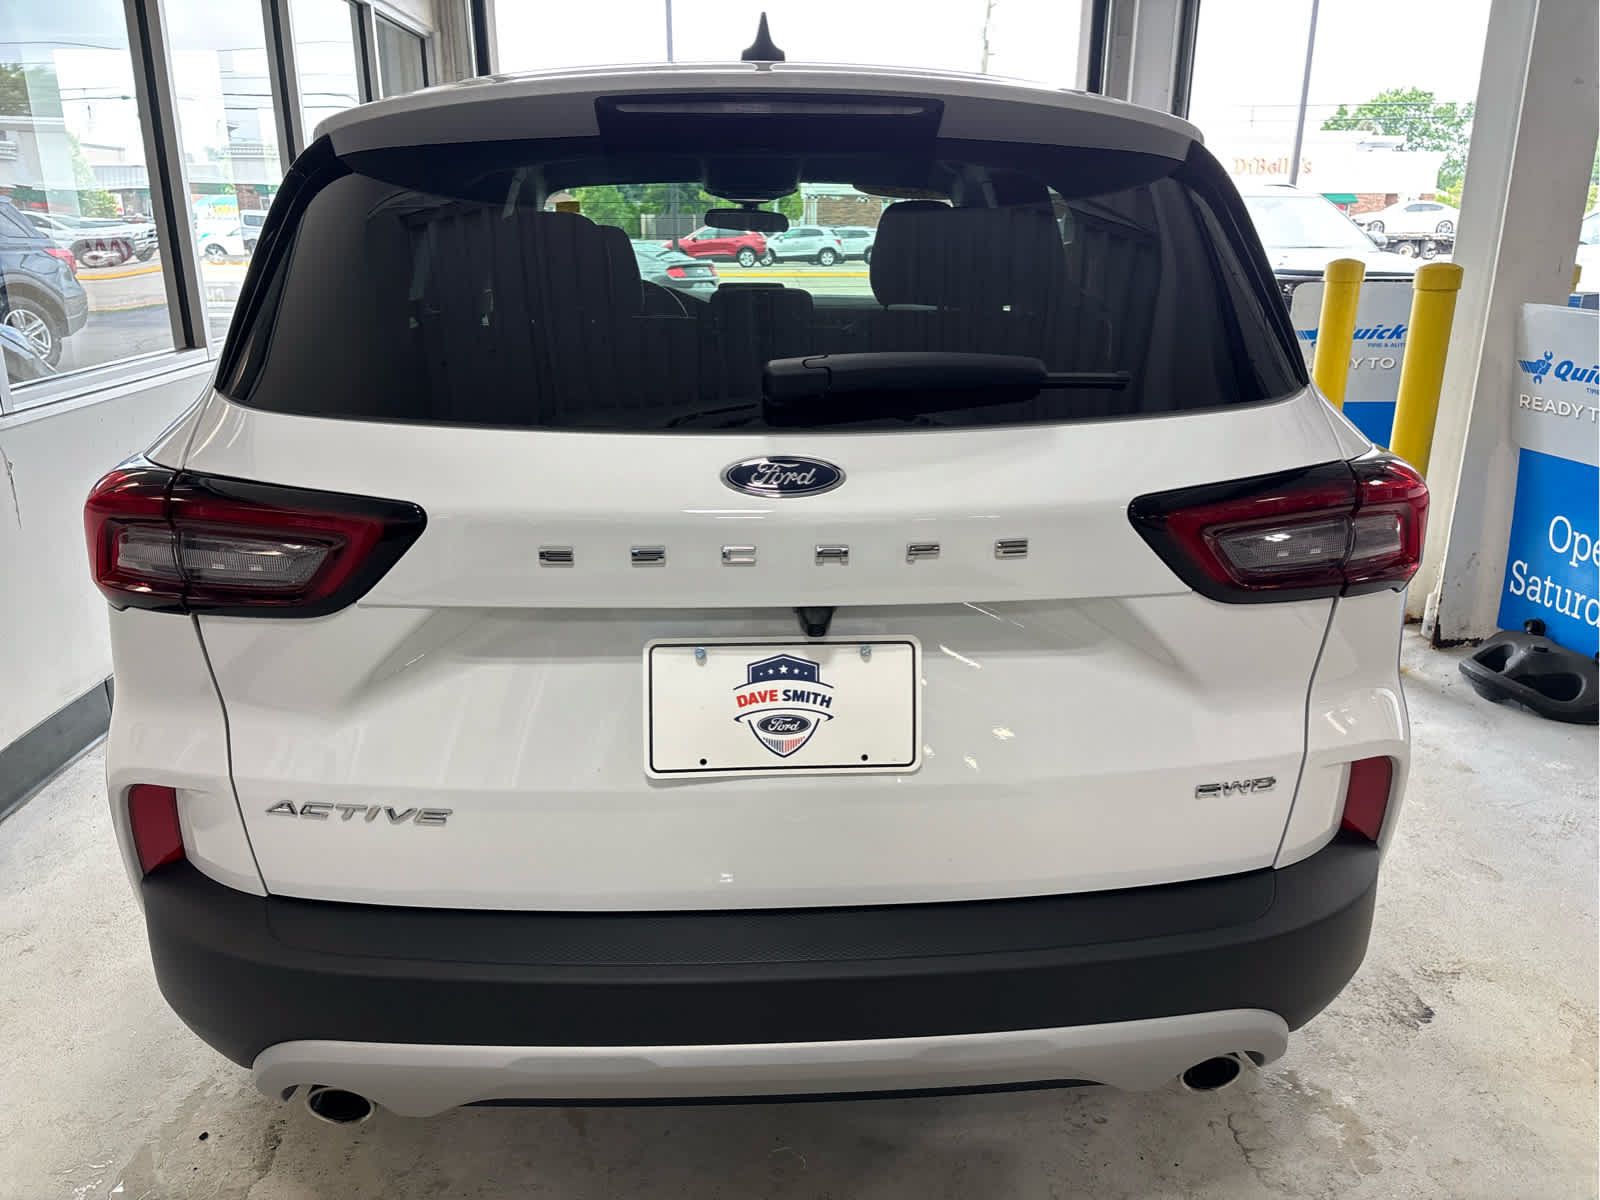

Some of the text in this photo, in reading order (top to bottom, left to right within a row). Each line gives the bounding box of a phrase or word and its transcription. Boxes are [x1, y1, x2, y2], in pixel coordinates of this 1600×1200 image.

[1352, 324, 1408, 340] uick
[1367, 357, 1397, 369] TO
[1519, 393, 1585, 419] READY
[538, 537, 1029, 567] ESCAPE
[736, 688, 833, 709] DAVE SMITH
[264, 799, 454, 826] ACTIVE
